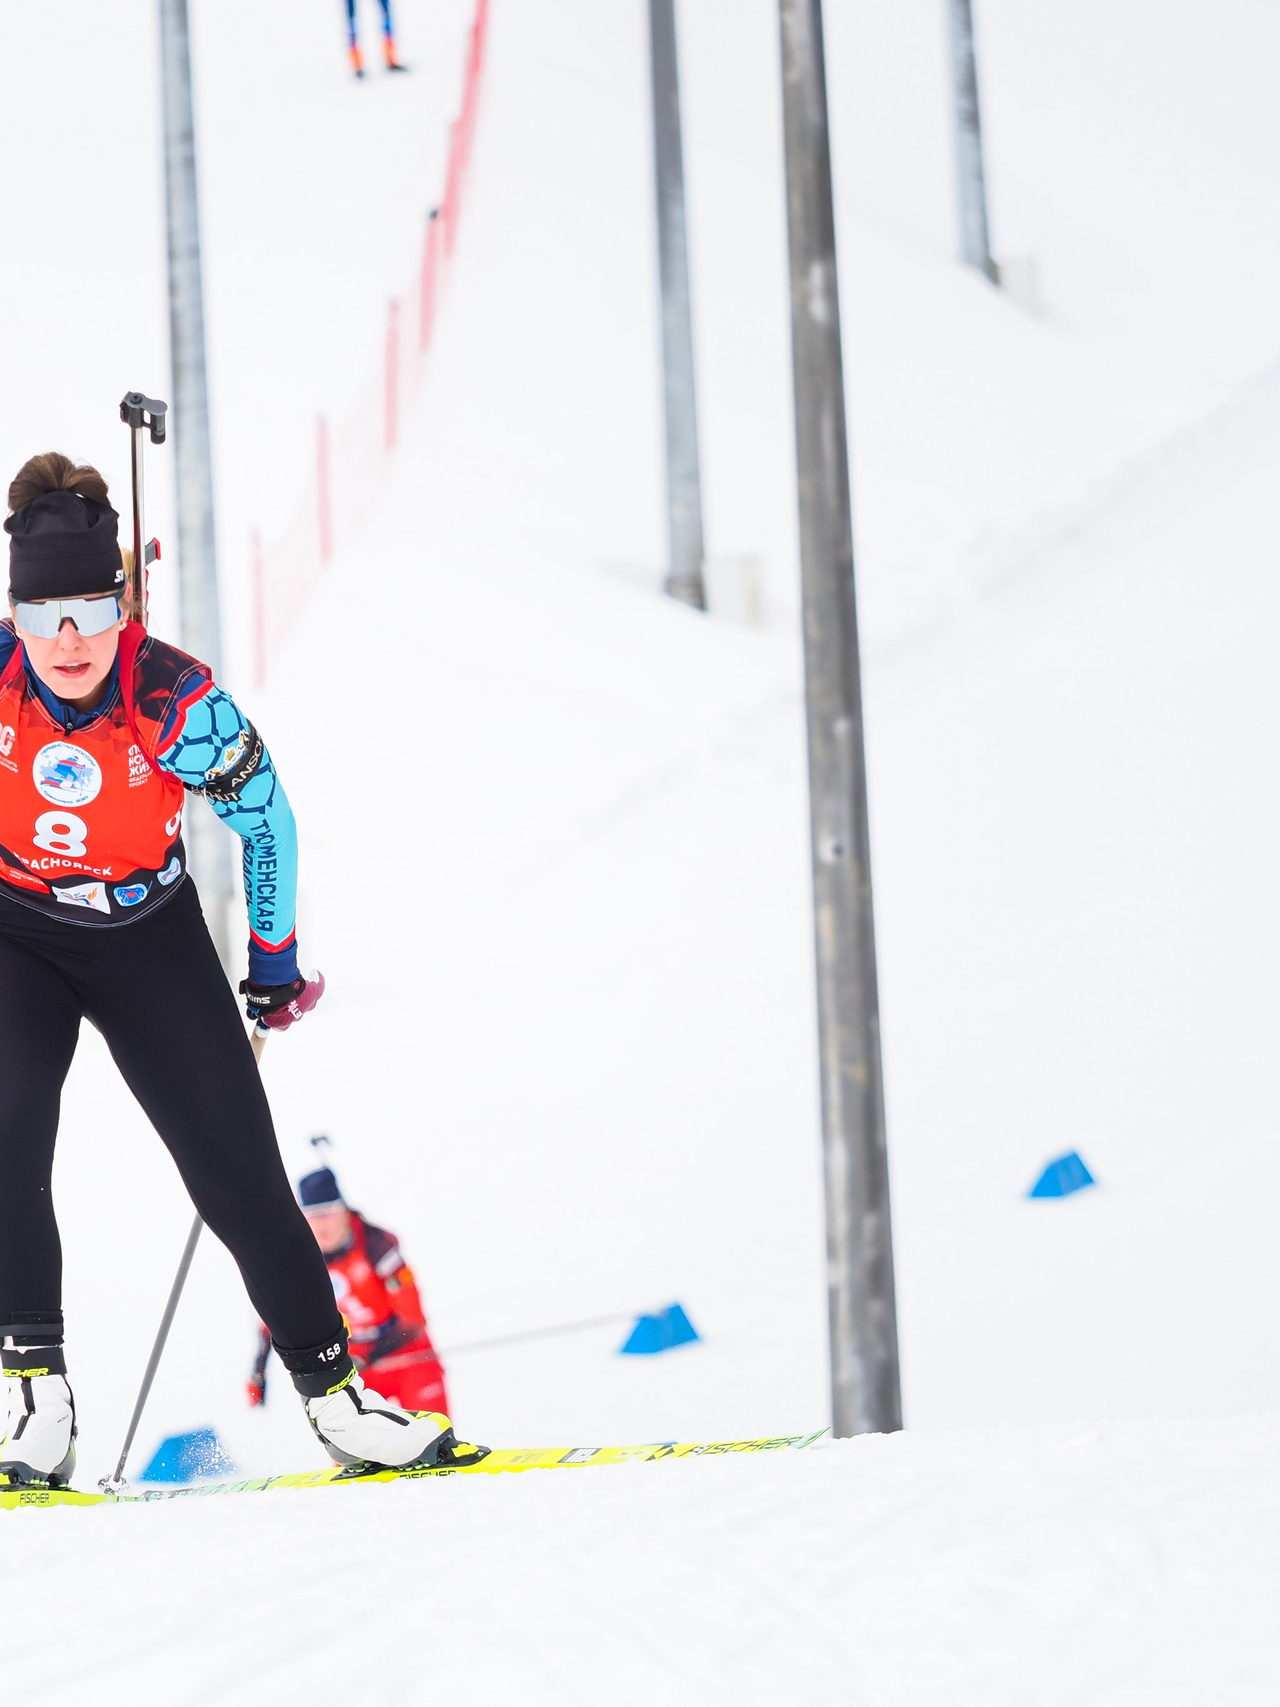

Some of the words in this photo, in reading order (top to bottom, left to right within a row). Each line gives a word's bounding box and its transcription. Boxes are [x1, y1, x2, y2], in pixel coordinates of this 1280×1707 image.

[128, 761, 150, 777] ЖИЗ
[231, 733, 263, 788] ANSCH
[32, 810, 88, 858] 8
[249, 818, 278, 933] ТЮМЕНСКАЯ
[317, 1342, 341, 1363] 158
[2, 1367, 50, 1378] SCHER
[325, 1363, 357, 1397] FISC
[19, 1492, 50, 1505] FISCHER
